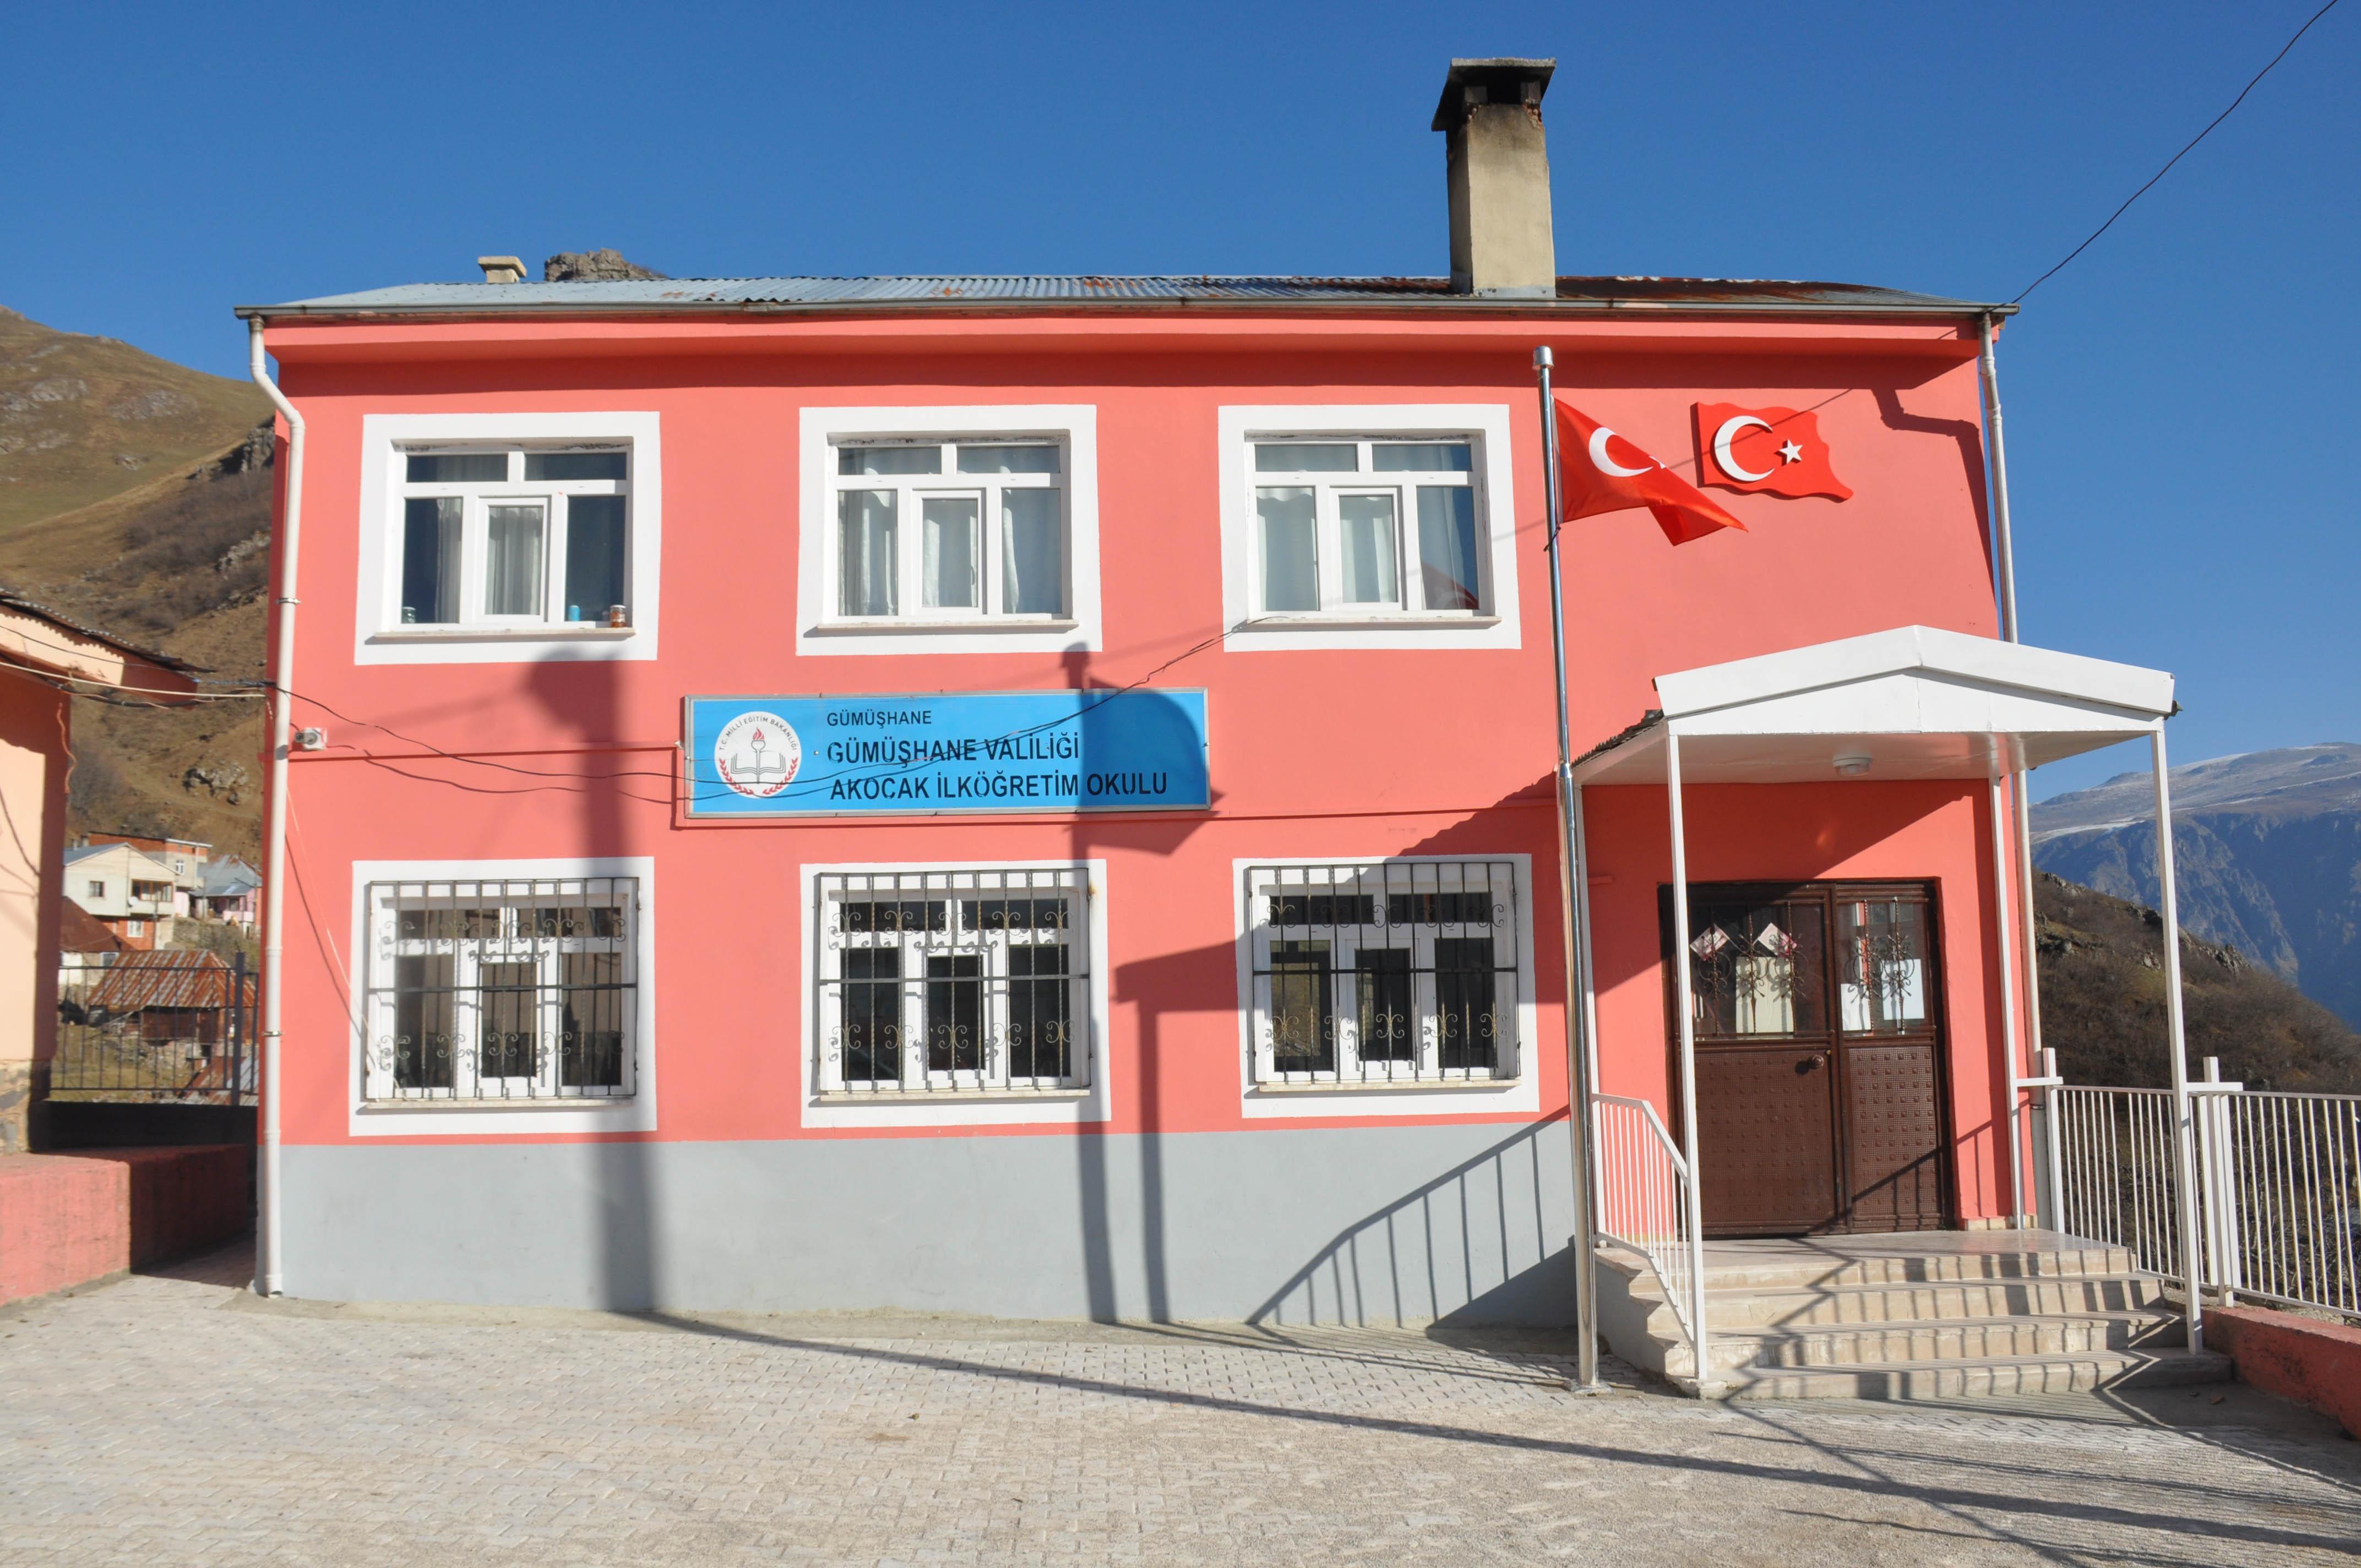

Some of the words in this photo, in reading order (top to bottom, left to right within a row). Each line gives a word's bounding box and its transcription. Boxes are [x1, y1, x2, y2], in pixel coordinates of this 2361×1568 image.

[725, 721, 742, 738] MİLLİ
[743, 715, 769, 725] EĞİTİM
[770, 718, 798, 750] BAKANLIĞI
[826, 710, 932, 728] GÜMÜŞHANE
[827, 737, 977, 769] GÜMÜŞHANE
[986, 732, 1079, 761] VALİLİĞİ
[830, 776, 931, 800] AKOCAK
[937, 769, 1079, 798] İLKÖĞRETİM
[1086, 773, 1167, 795] OKULU
